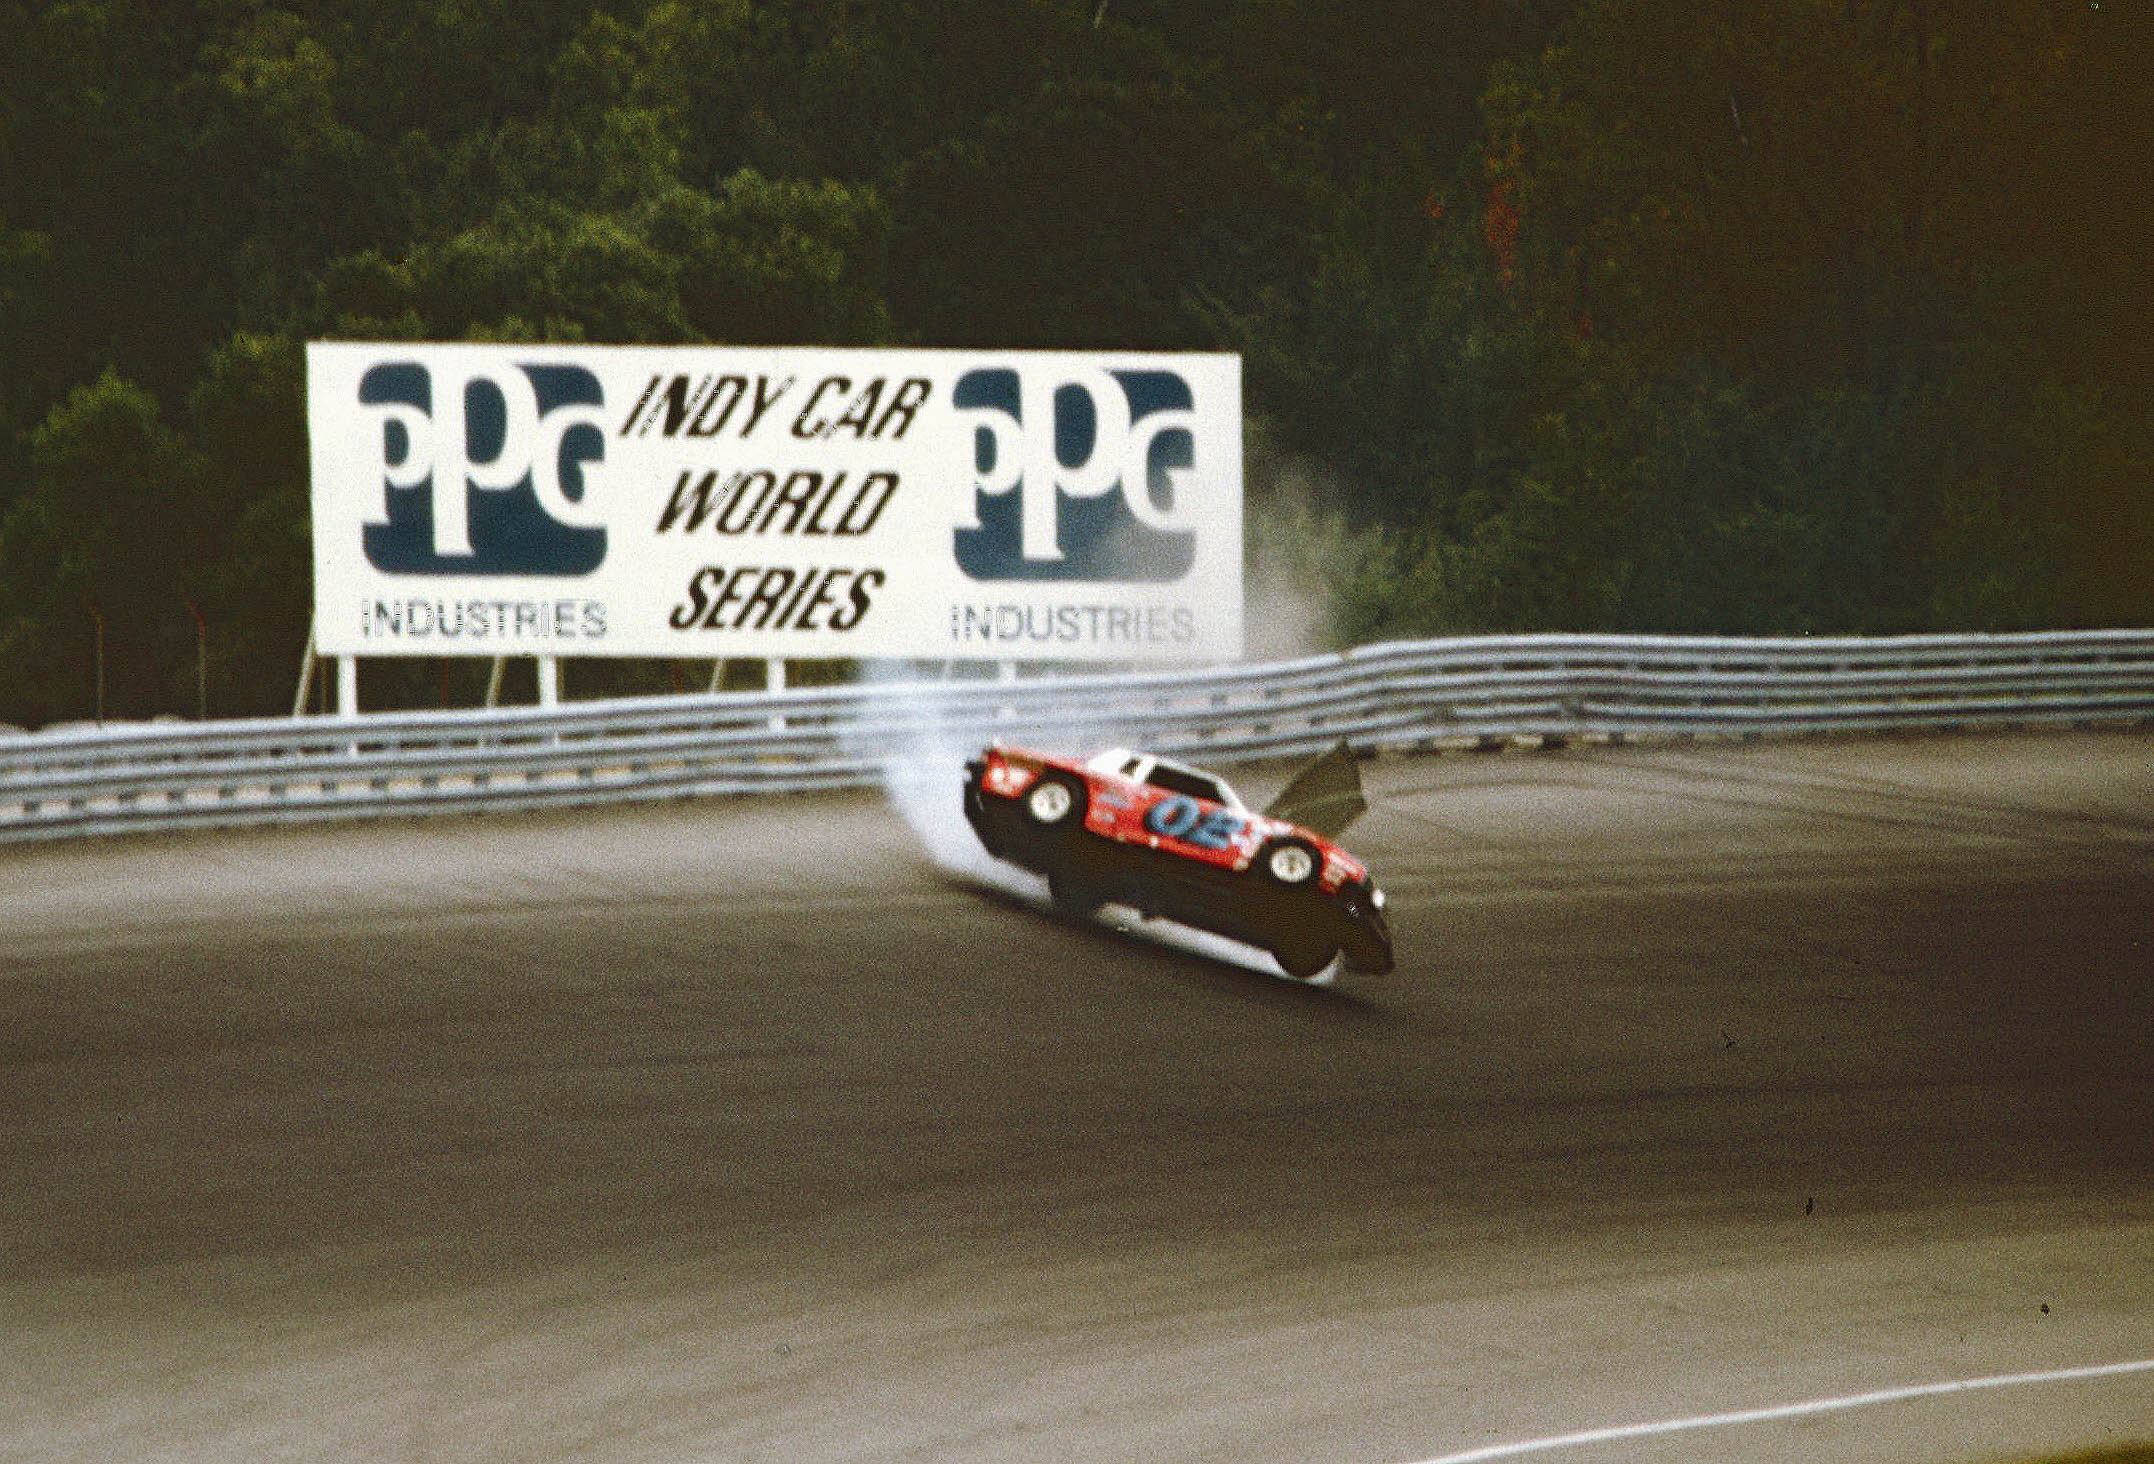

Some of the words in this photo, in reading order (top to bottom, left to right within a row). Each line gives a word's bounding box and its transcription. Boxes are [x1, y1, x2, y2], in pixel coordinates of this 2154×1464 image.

[619, 373, 796, 440] INDY
[790, 375, 933, 440] CAR
[655, 469, 900, 536] WORLD
[361, 600, 608, 638] INDUSTRIES
[668, 564, 886, 631] SERIES
[951, 603, 1195, 643] INDUSTRIES
